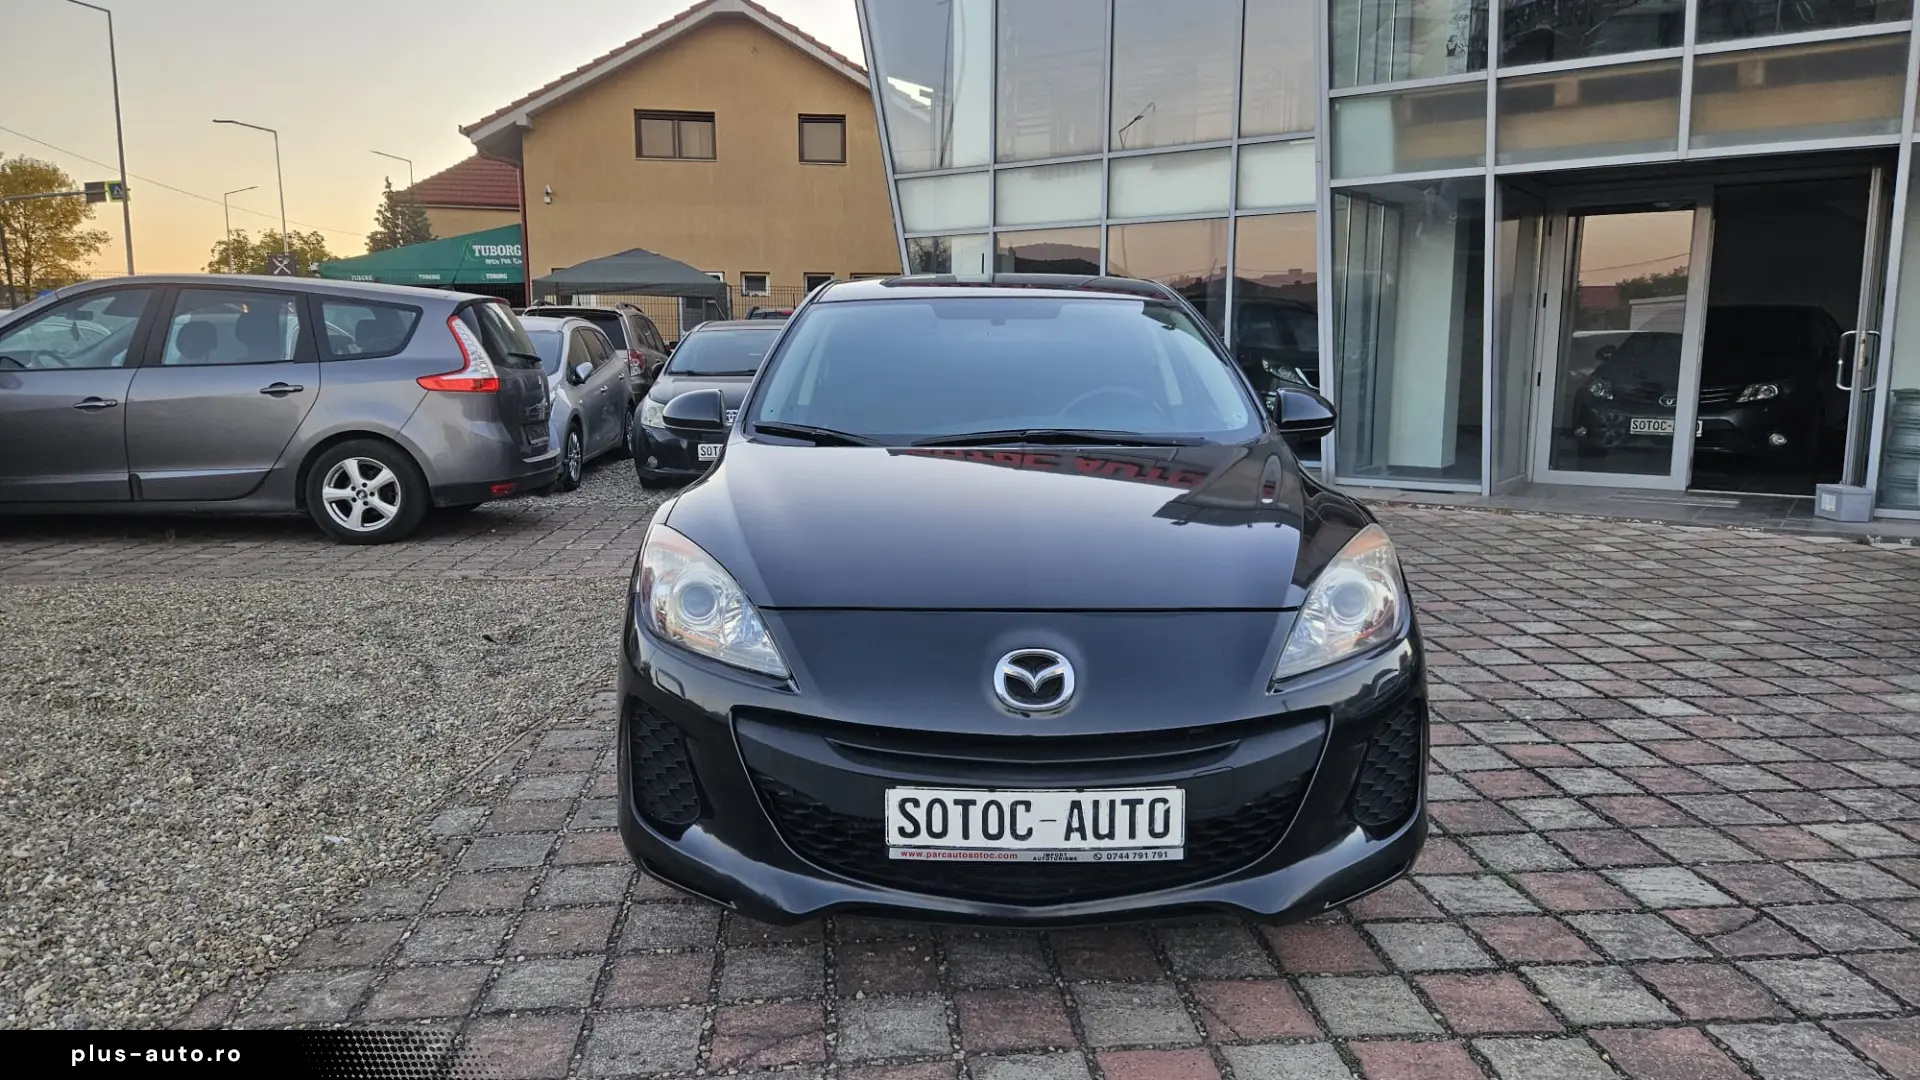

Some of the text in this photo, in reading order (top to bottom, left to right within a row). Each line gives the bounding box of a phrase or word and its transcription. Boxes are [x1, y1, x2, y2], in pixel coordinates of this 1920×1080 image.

[472, 244, 522, 257] TUBORG
[897, 797, 1171, 841] SOTOC-AUTO
[900, 850, 1018, 860] www.parcautosotoc.com
[1106, 851, 1168, 860] 0744 791 791
